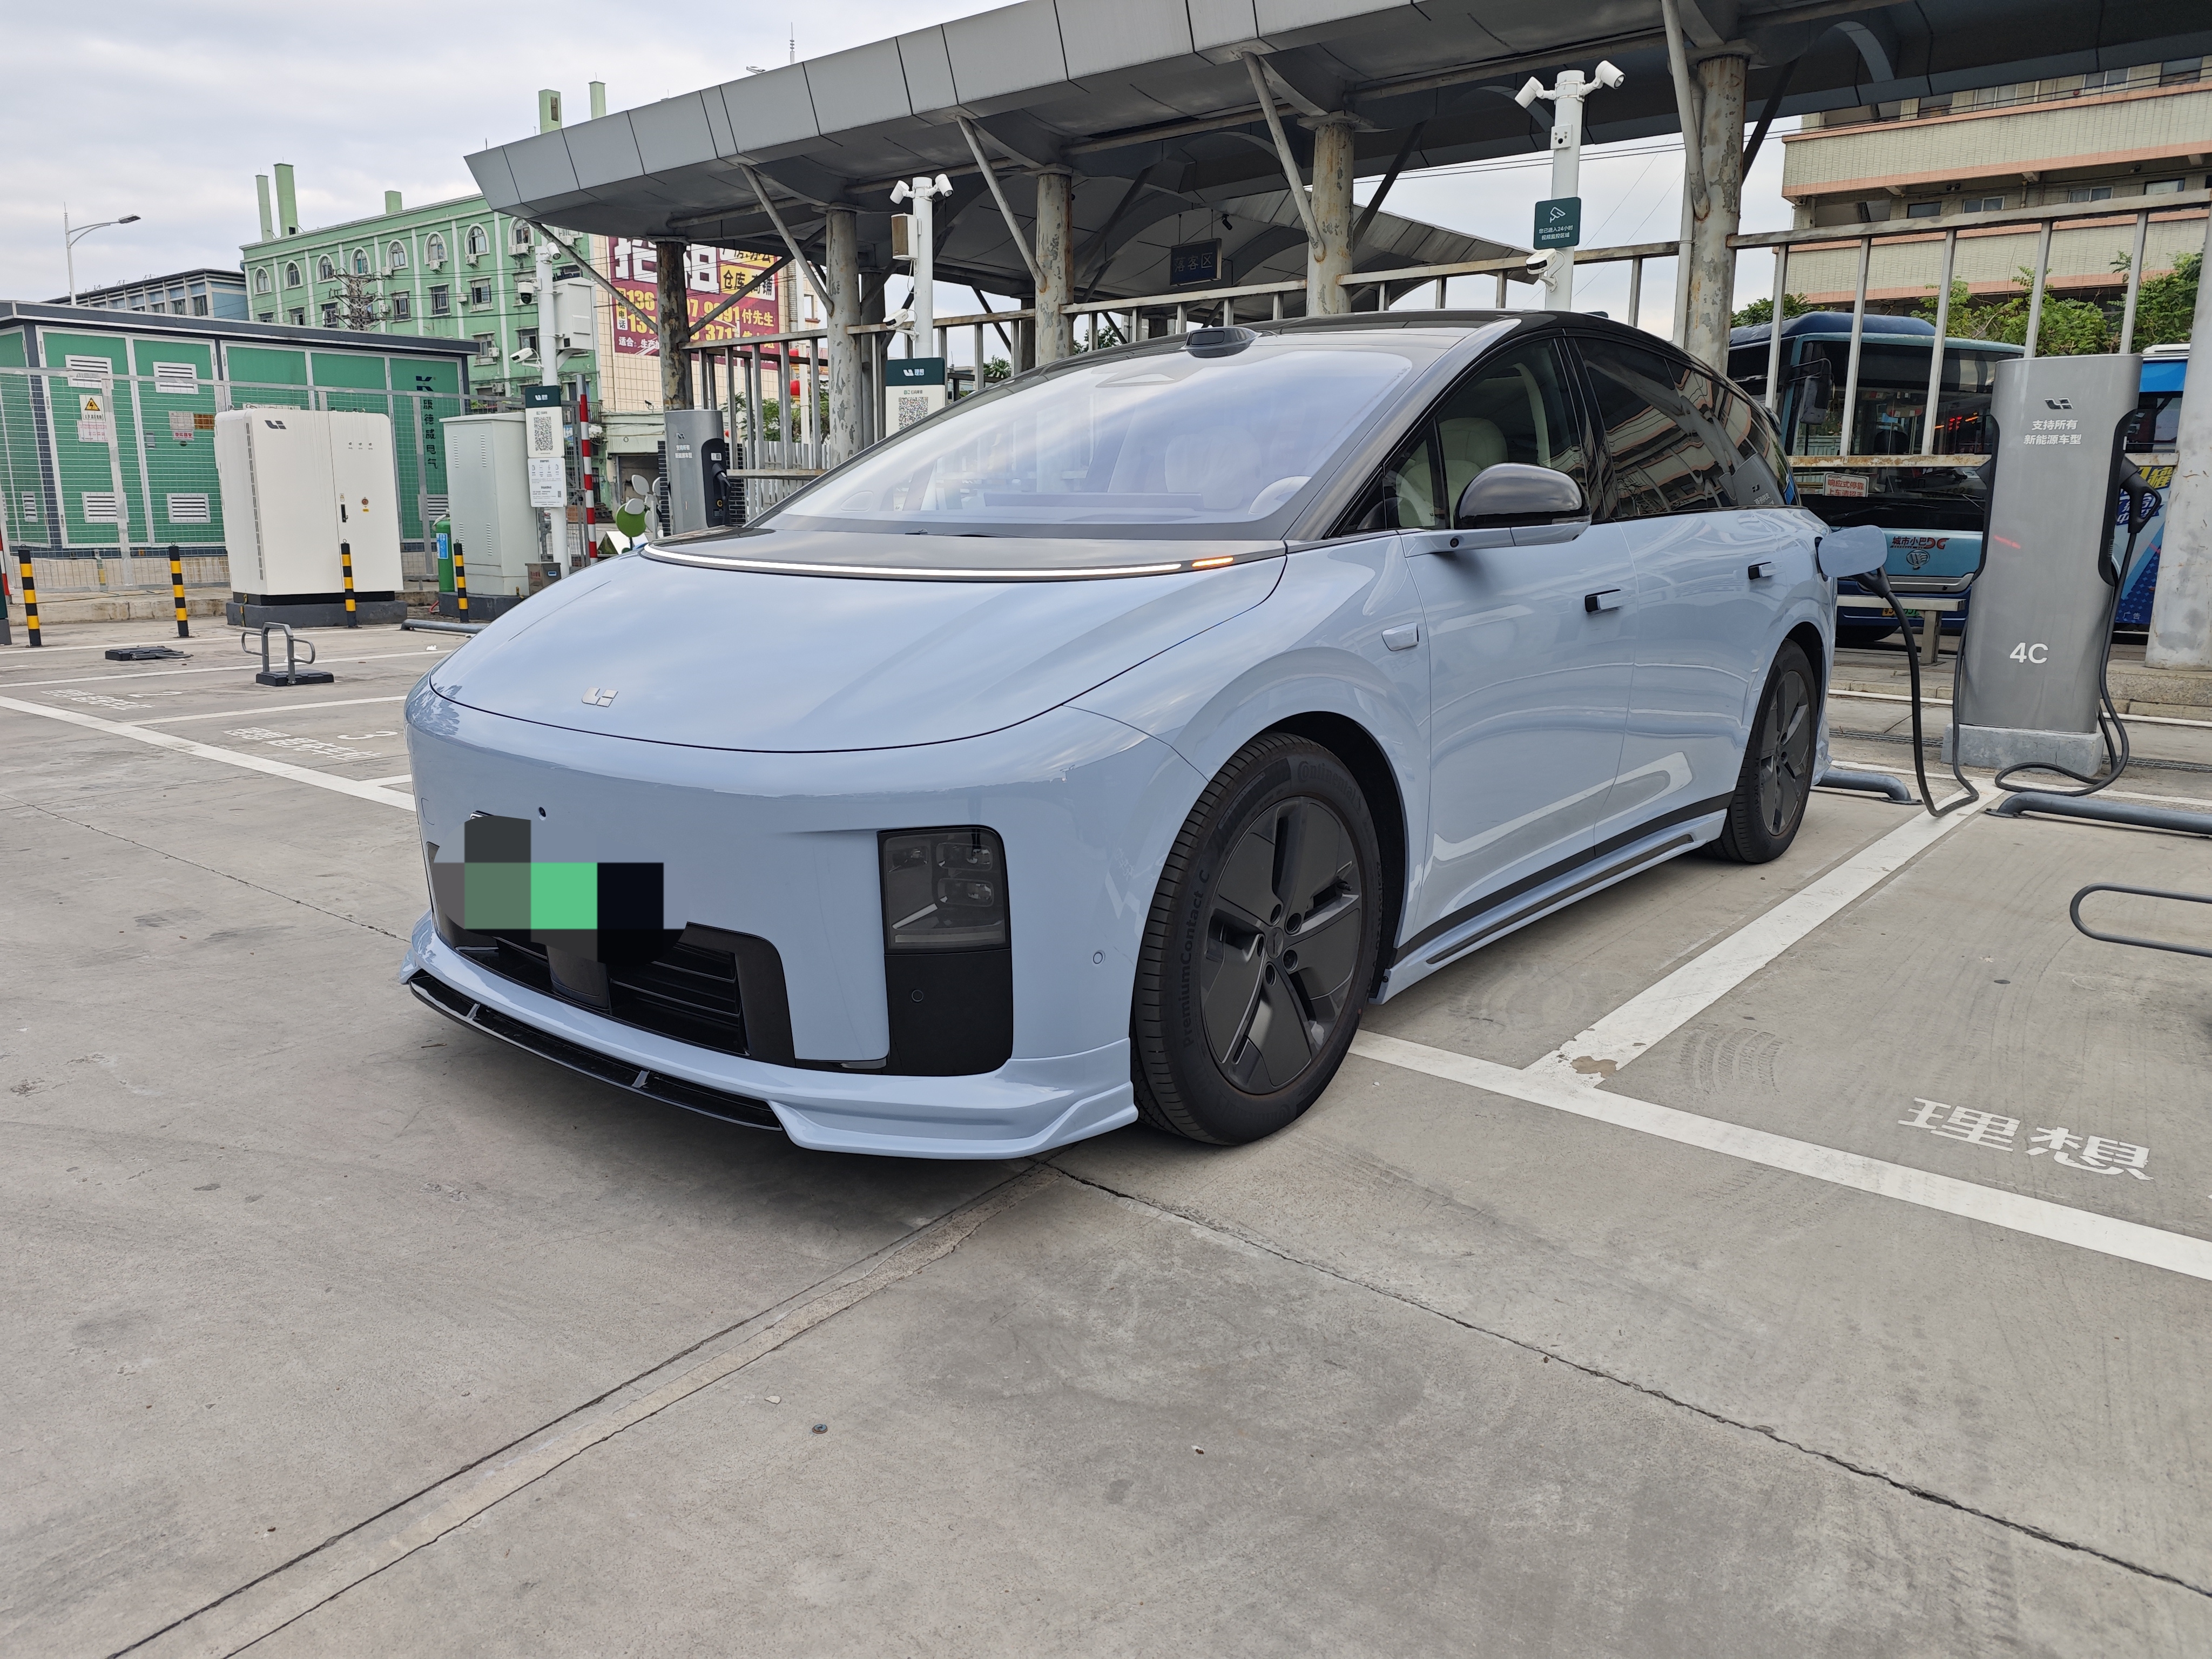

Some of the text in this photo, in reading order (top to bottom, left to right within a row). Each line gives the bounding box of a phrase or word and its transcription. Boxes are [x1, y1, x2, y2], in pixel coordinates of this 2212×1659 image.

[1539, 225, 1573, 234] 您已进入24小时
[1541, 232, 1570, 241] 视频监控区域
[1174, 252, 1213, 273] 落客区
[741, 308, 774, 327] 付先生
[2031, 419, 2079, 430] 支持所有
[2023, 434, 2082, 445] 新能源车型
[1827, 478, 1864, 490] 响应式停靠
[1892, 536, 1926, 546] 城市小巴
[2009, 642, 2049, 664] 4C
[1297, 760, 1357, 804] Continental
[1178, 889, 1204, 1048] PremiumContact
[1897, 1097, 2154, 1182] 理想
